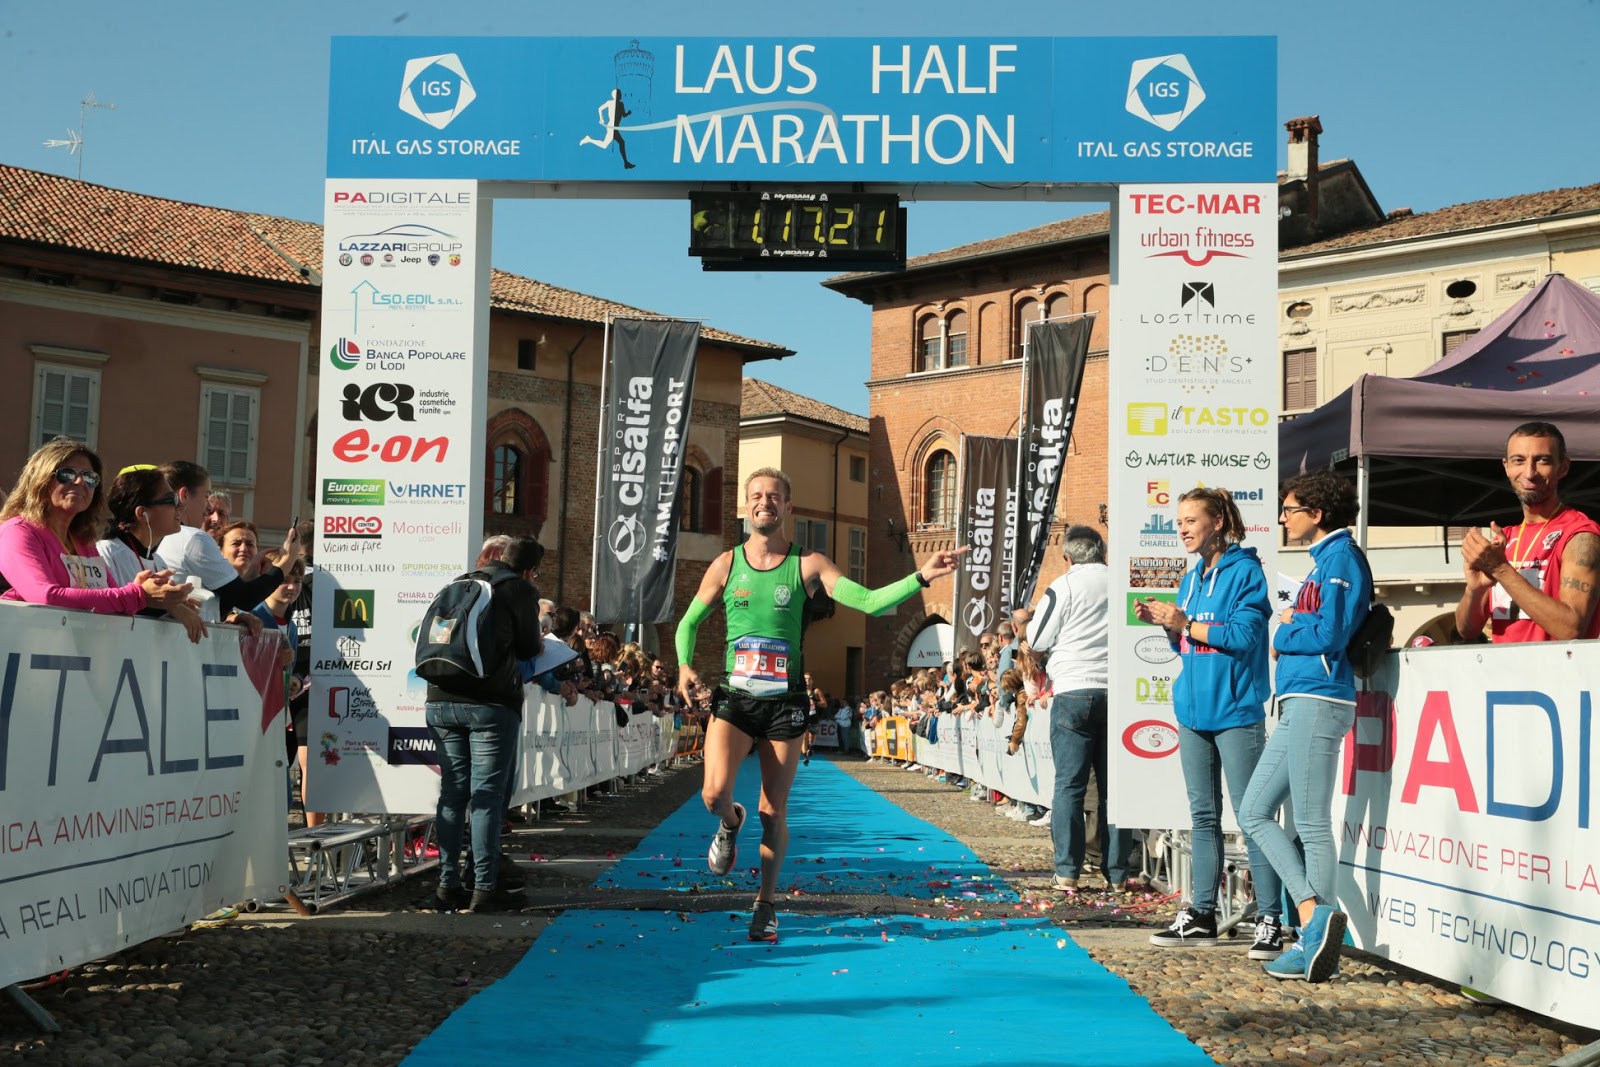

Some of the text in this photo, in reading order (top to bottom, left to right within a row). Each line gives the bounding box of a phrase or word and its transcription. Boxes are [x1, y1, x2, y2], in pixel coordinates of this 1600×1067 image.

[674, 44, 1018, 95] LAUS HALF
[422, 81, 451, 96] IGS
[1148, 82, 1180, 98] IGS
[352, 139, 520, 156] ITAL GAS STORAGE
[672, 114, 1015, 165] MARATHON
[1078, 142, 1253, 158] ITAL GAS STORAGE
[1129, 194, 1261, 215] TEC-MAR
[1141, 226, 1255, 247] urban fitness
[400, 256, 422, 264] Jeep
[1140, 313, 1255, 325] LOST TIME
[419, 390, 449, 398] industrie
[419, 407, 441, 415] riunite
[611, 376, 654, 506] cisalfa
[1145, 453, 1250, 467] NATUR HOUSE
[327, 481, 381, 495] Europcar
[408, 484, 466, 498] HRNET
[392, 522, 462, 535] Monticelli
[1244, 525, 1270, 533] aulica
[323, 540, 382, 554] Vicini di fare
[965, 487, 996, 591] cisalfa
[1139, 540, 1178, 548] CHIARELLI
[314, 660, 392, 671] AEMMEGI Srl
[751, 654, 768, 671] 75
[0, 653, 244, 791] ITALE
[1342, 690, 1592, 830] PADI
[0, 791, 241, 853] ICA AMMINISTRAZIONE
[1340, 820, 1489, 872] INNOVAZIONE
[1500, 848, 1551, 885] PER
[19, 893, 87, 935] REAL
[99, 860, 215, 915] INNOVATION
[1370, 893, 1417, 928] WEB
